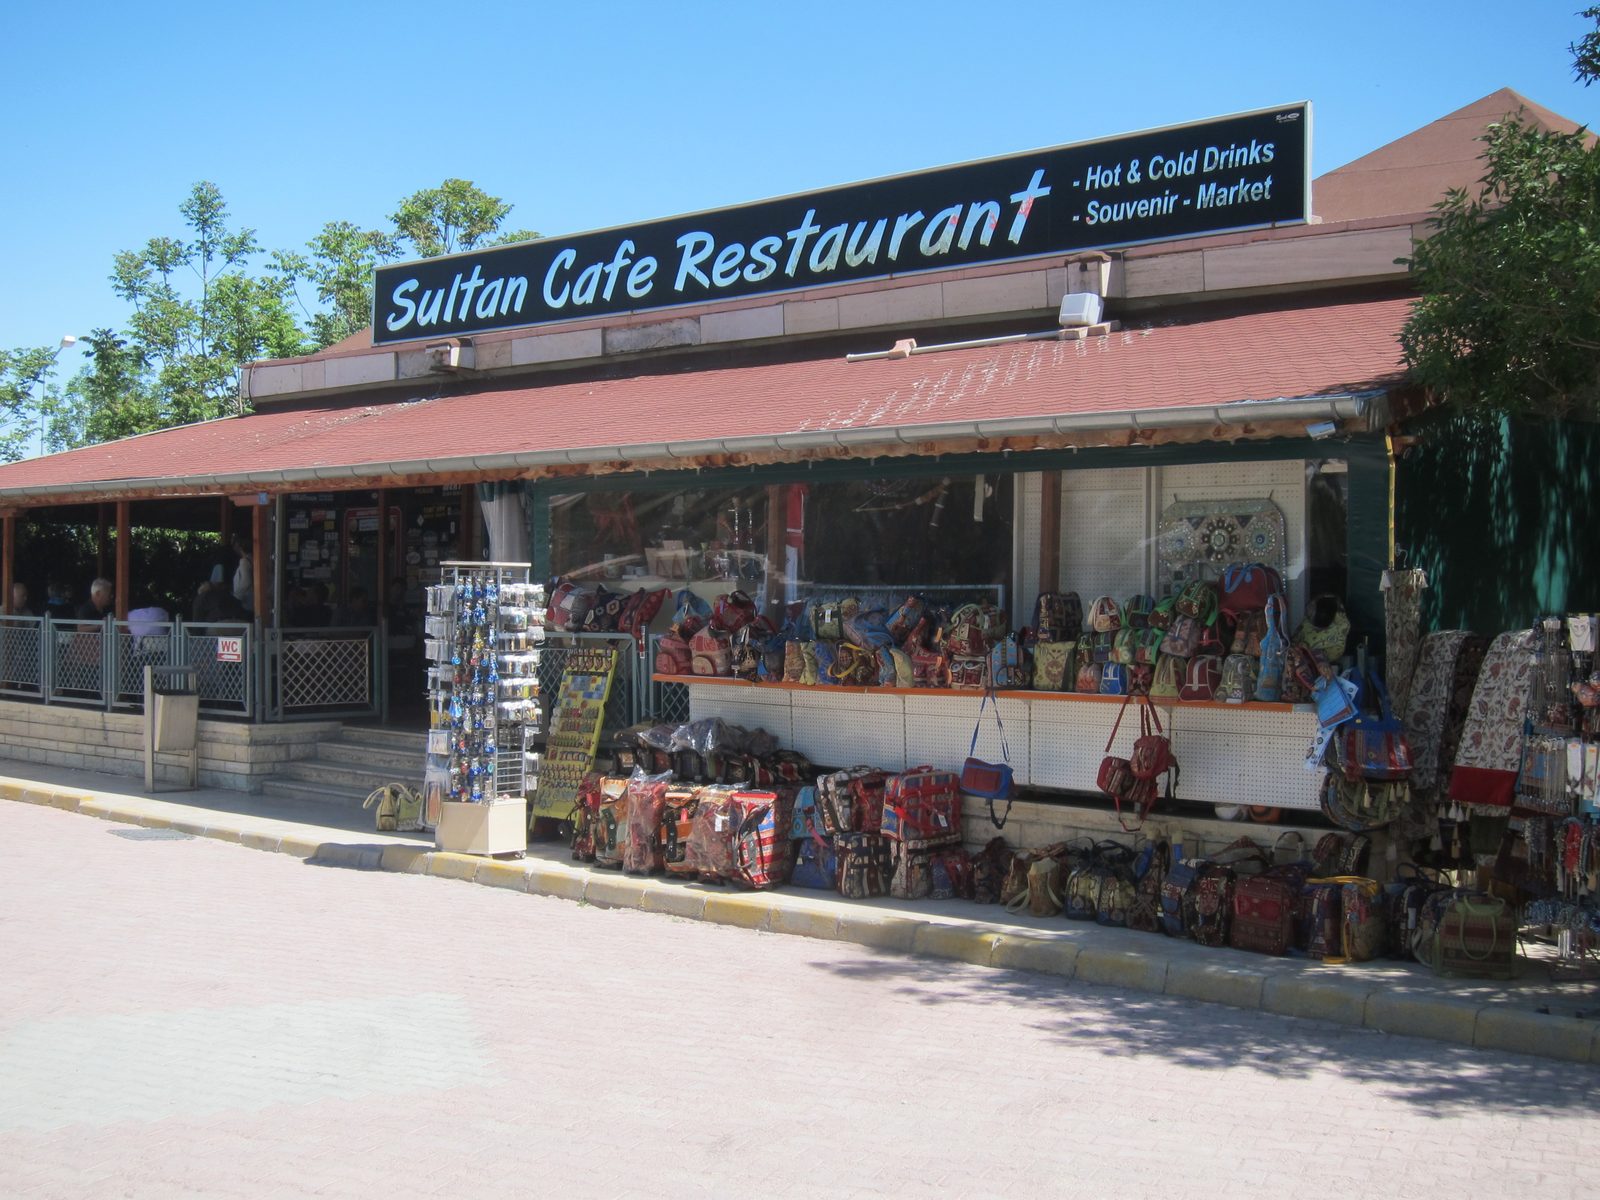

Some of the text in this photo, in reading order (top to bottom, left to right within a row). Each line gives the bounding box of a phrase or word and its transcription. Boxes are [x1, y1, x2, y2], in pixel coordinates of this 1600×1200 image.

[1085, 163, 1121, 190] Hot
[1127, 159, 1141, 184] &
[1149, 149, 1198, 181] Cold
[1203, 139, 1275, 173] Drinks
[1086, 189, 1179, 225] Souvenir
[1197, 175, 1273, 210] Market
[387, 169, 1051, 331] Sultan Cafe Restaurant
[221, 640, 238, 653] WC
